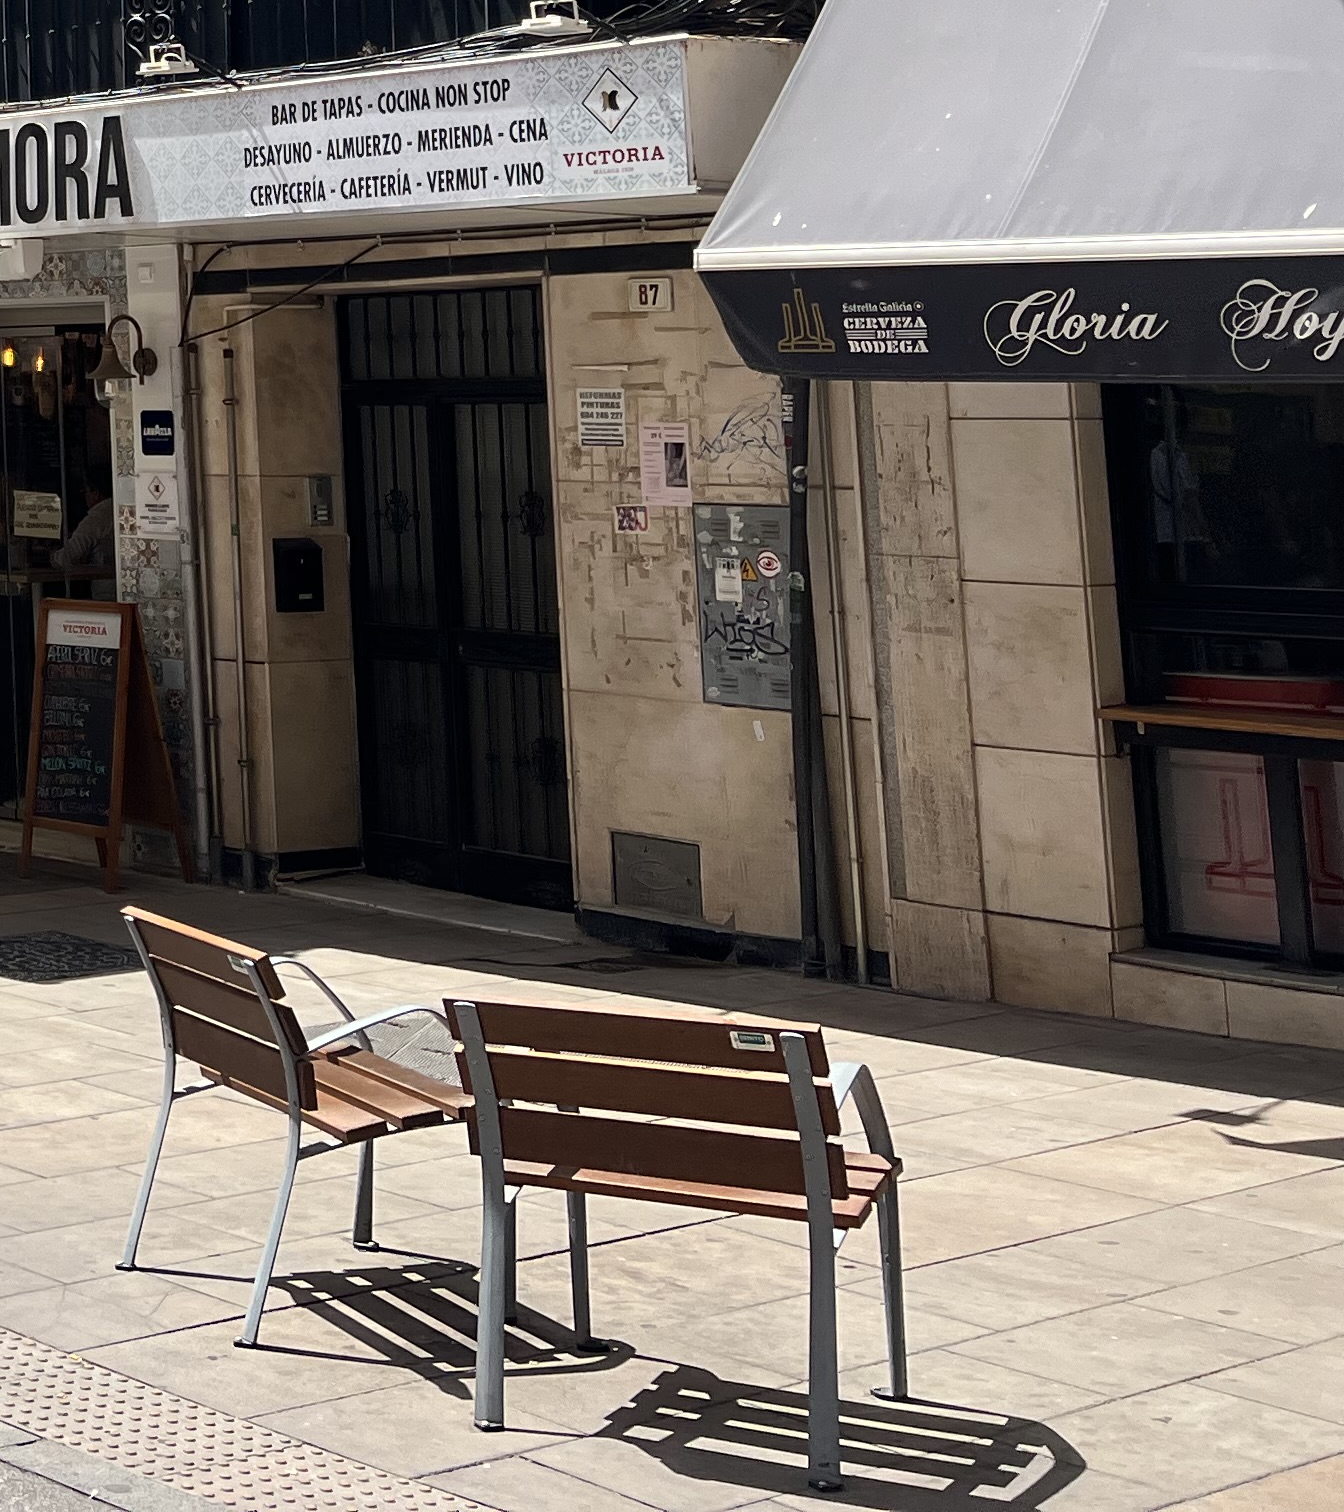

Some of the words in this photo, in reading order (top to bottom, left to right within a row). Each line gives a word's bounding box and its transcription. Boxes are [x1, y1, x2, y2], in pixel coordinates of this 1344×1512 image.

[271, 103, 297, 126] BAR
[302, 100, 317, 122] DE
[322, 96, 363, 121] TAPAS
[378, 88, 431, 115] COCINA
[435, 83, 468, 108] NON
[473, 79, 511, 104] STOP
[244, 141, 312, 168] DESAYUNO
[326, 132, 402, 160] ALMUERZO
[417, 123, 494, 153] MERIENDA
[509, 117, 549, 144] CENA
[563, 146, 665, 167] VICTORIA
[250, 175, 326, 207] CERVECERÍA
[340, 168, 411, 200] CAFETERÍA
[427, 166, 488, 193] VERMUT
[504, 161, 544, 187] VINO
[638, 284, 659, 306] 87
[842, 303, 878, 313] Estrella
[879, 301, 912, 312] Galicia
[843, 316, 927, 329] CERVEZA
[984, 288, 1169, 366] Gloria
[876, 330, 895, 339] DE
[848, 340, 929, 354] BODEGA
[581, 401, 621, 409] PINTURAS
[63, 624, 107, 636] VICTORIA
